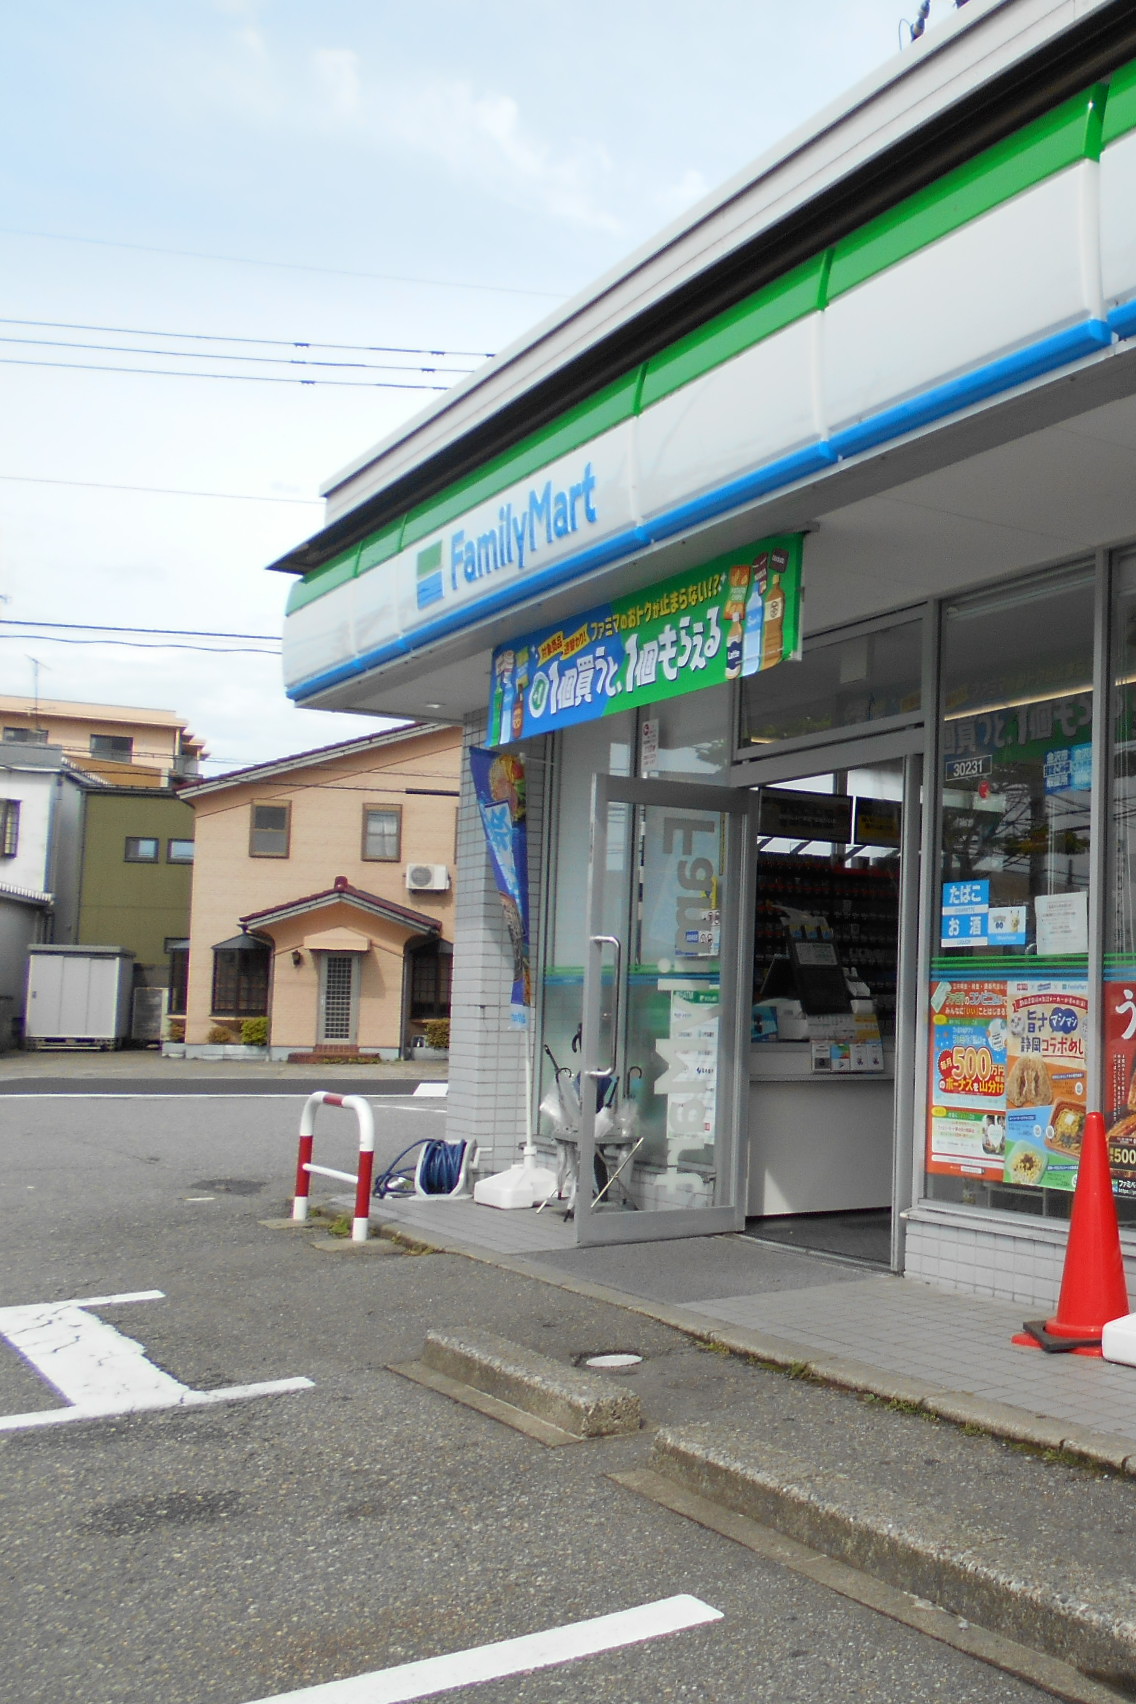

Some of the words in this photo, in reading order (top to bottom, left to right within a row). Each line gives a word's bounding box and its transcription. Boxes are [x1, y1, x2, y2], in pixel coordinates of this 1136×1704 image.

[451, 462, 597, 590] FamilyMart
[953, 760, 983, 776] 30231
[949, 884, 981, 903] たばこ
[1021, 1036, 1084, 1055] 静岡コラボめし
